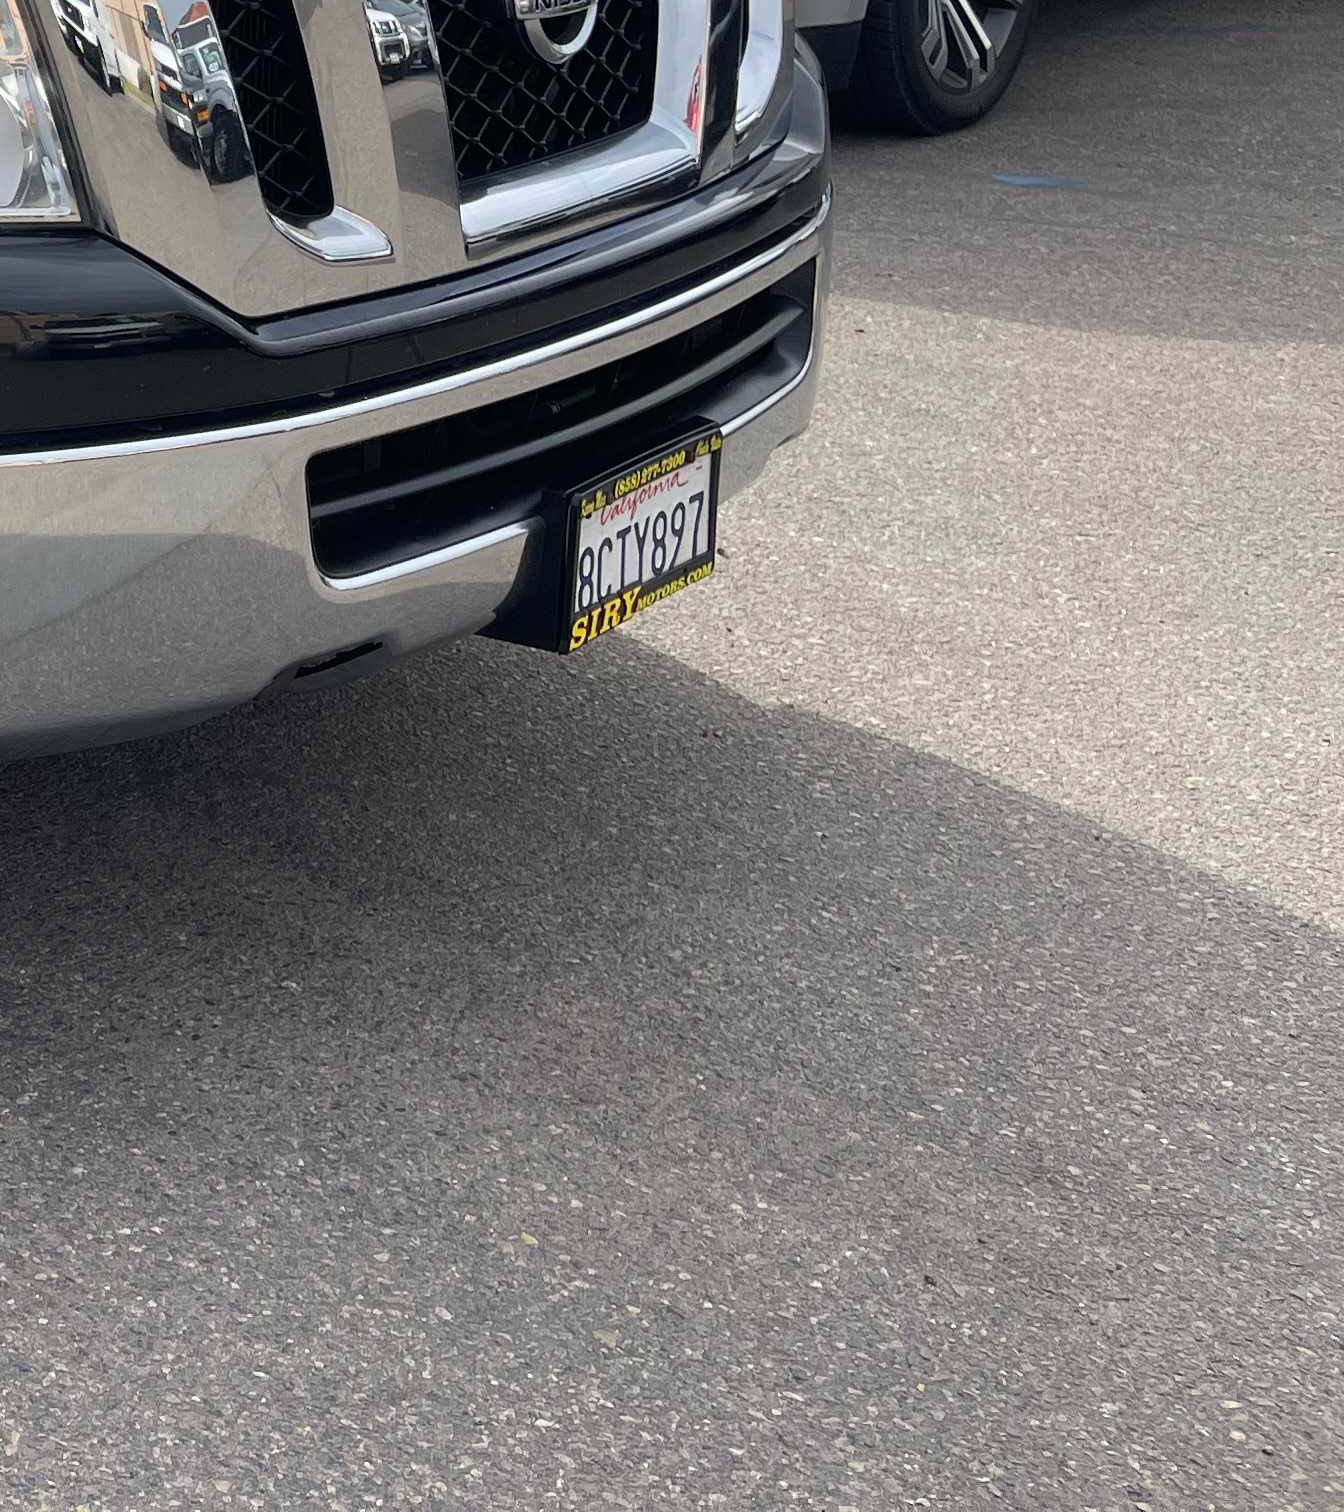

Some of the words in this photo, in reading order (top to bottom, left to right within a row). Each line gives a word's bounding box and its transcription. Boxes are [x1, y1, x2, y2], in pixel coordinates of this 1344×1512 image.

[600, 471, 688, 525] California
[578, 490, 704, 611] 8CTY897
[569, 586, 641, 651] SIRY
[637, 562, 713, 609] MOTORS.COM
